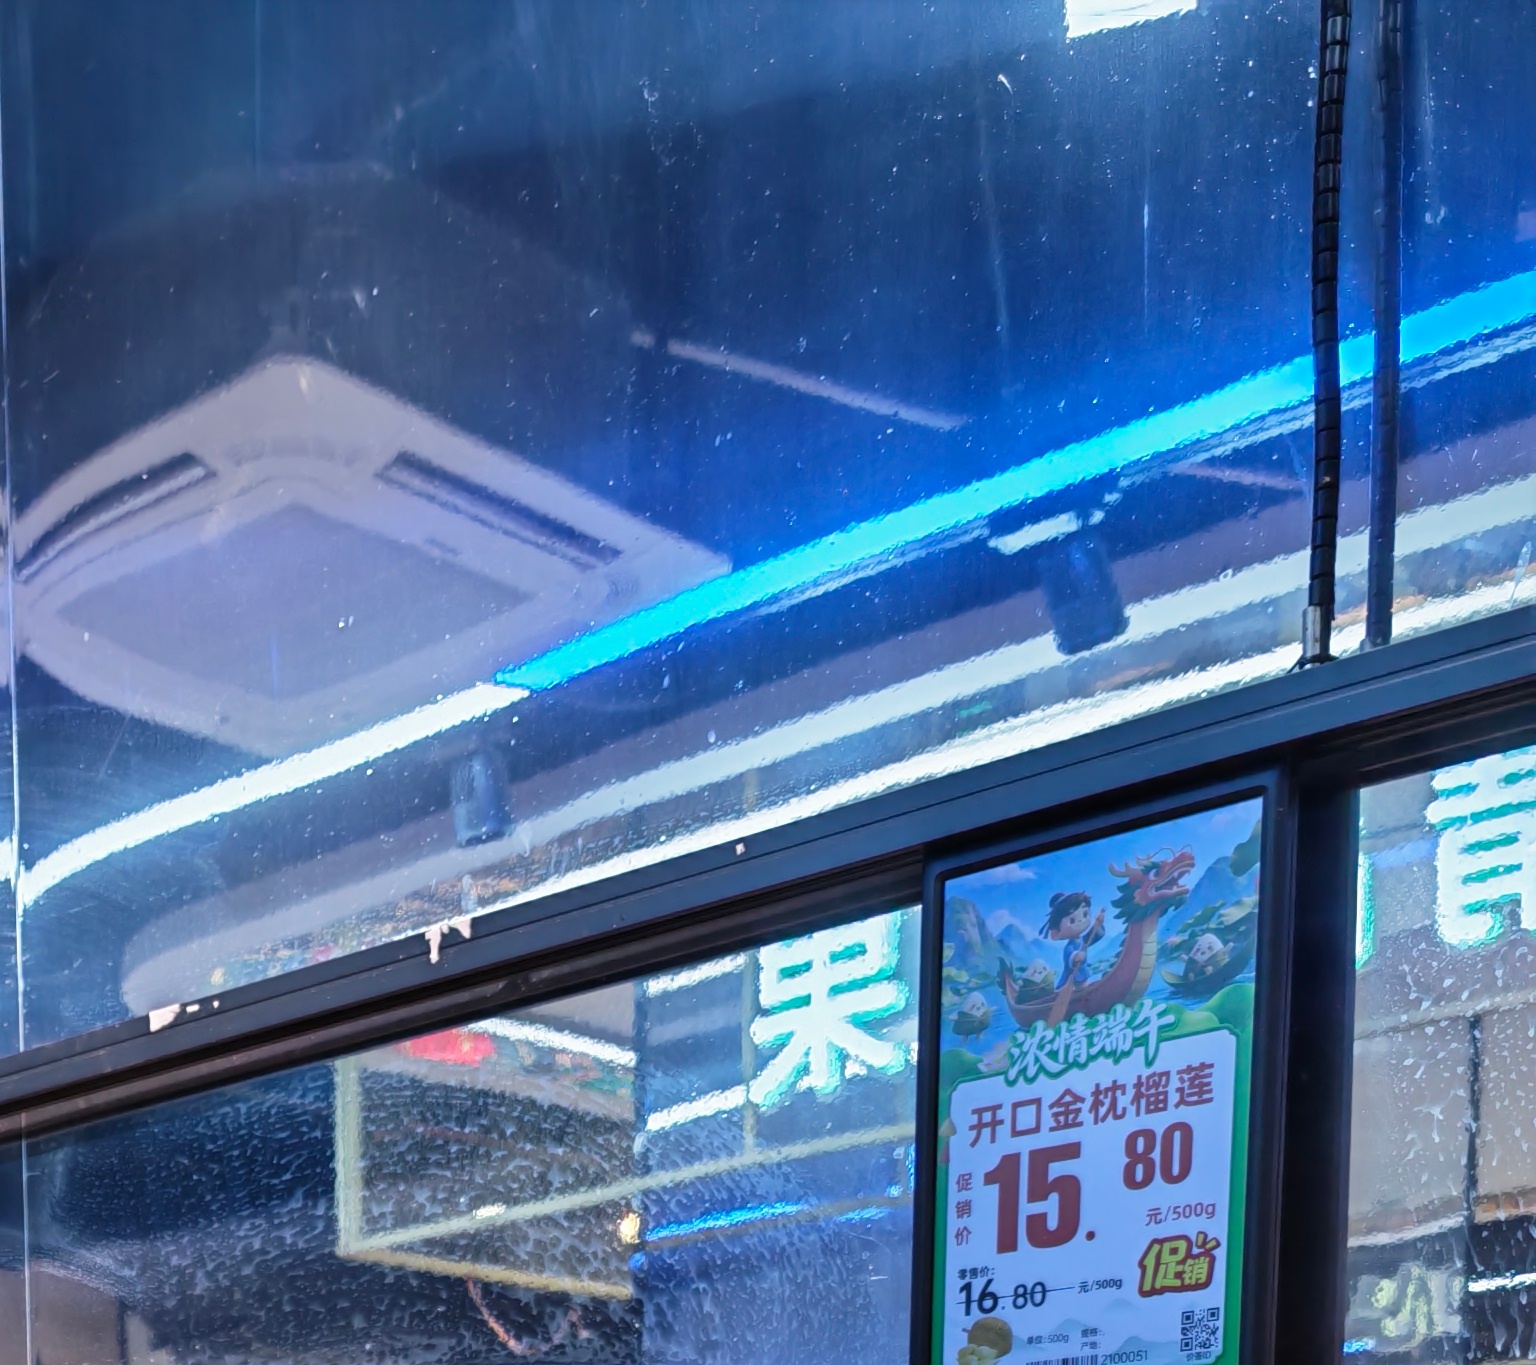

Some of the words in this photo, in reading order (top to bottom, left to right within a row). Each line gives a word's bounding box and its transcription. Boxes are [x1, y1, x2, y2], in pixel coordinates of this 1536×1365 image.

[1007, 999, 1176, 1079] 浓情端午
[969, 1062, 1215, 1148] 开口金枕榴莲
[954, 1172, 973, 1246] 促销价
[1146, 1202, 1216, 1226] 元/500g
[1141, 1239, 1210, 1293] 促销
[1101, 1349, 1148, 1365] 2100051
